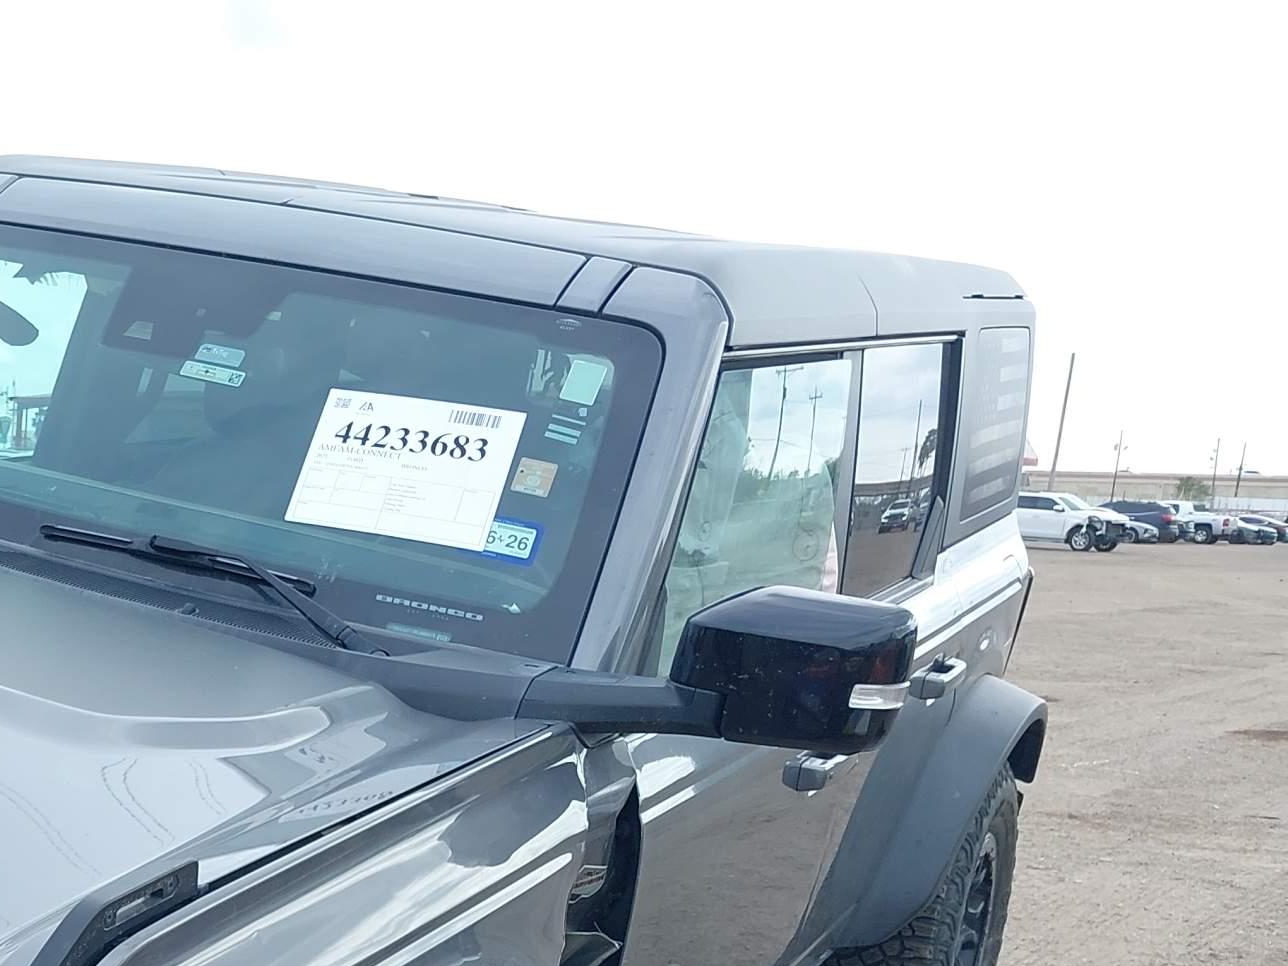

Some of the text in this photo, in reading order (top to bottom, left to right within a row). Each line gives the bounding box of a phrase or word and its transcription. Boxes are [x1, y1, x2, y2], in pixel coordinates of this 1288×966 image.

[334, 420, 490, 462] 44233683
[504, 534, 530, 551] 26
[375, 593, 484, 621] BRONCO
